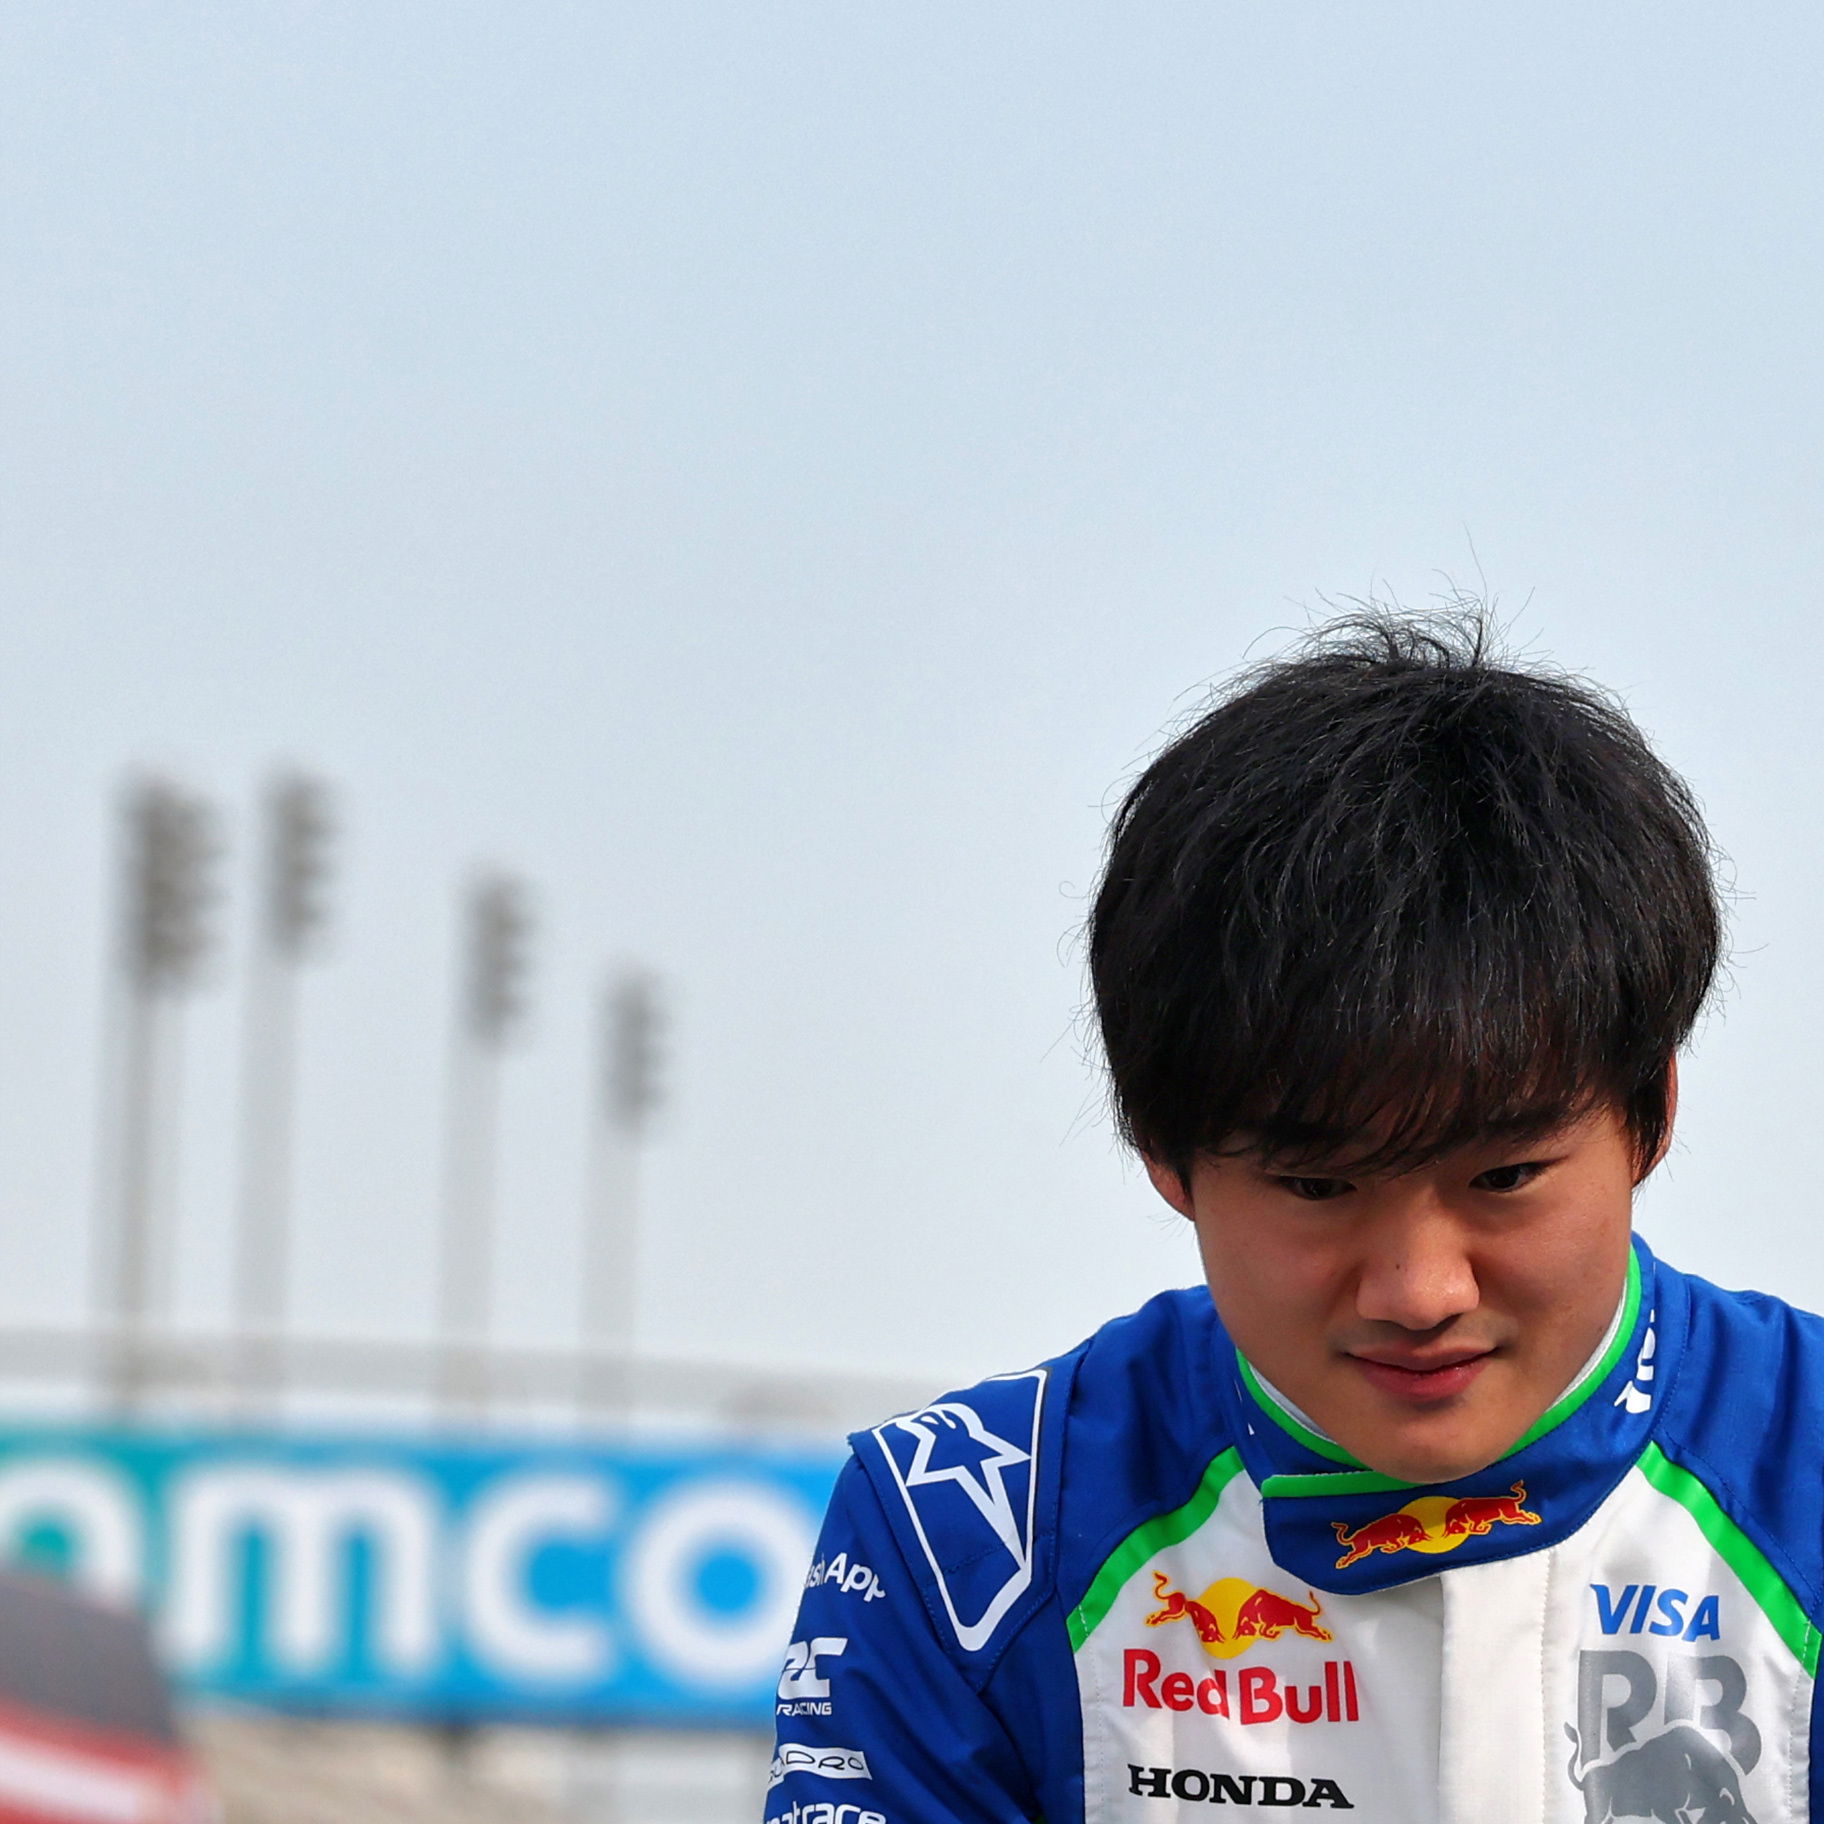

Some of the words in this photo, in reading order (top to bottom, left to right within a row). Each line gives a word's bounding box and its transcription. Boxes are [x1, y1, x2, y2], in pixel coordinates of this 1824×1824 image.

[1590, 1583, 1720, 1643] VISA
[1122, 1649, 1230, 1719] Red
[1239, 1660, 1360, 1726] Bull
[1127, 1764, 1354, 1808] HONDA
